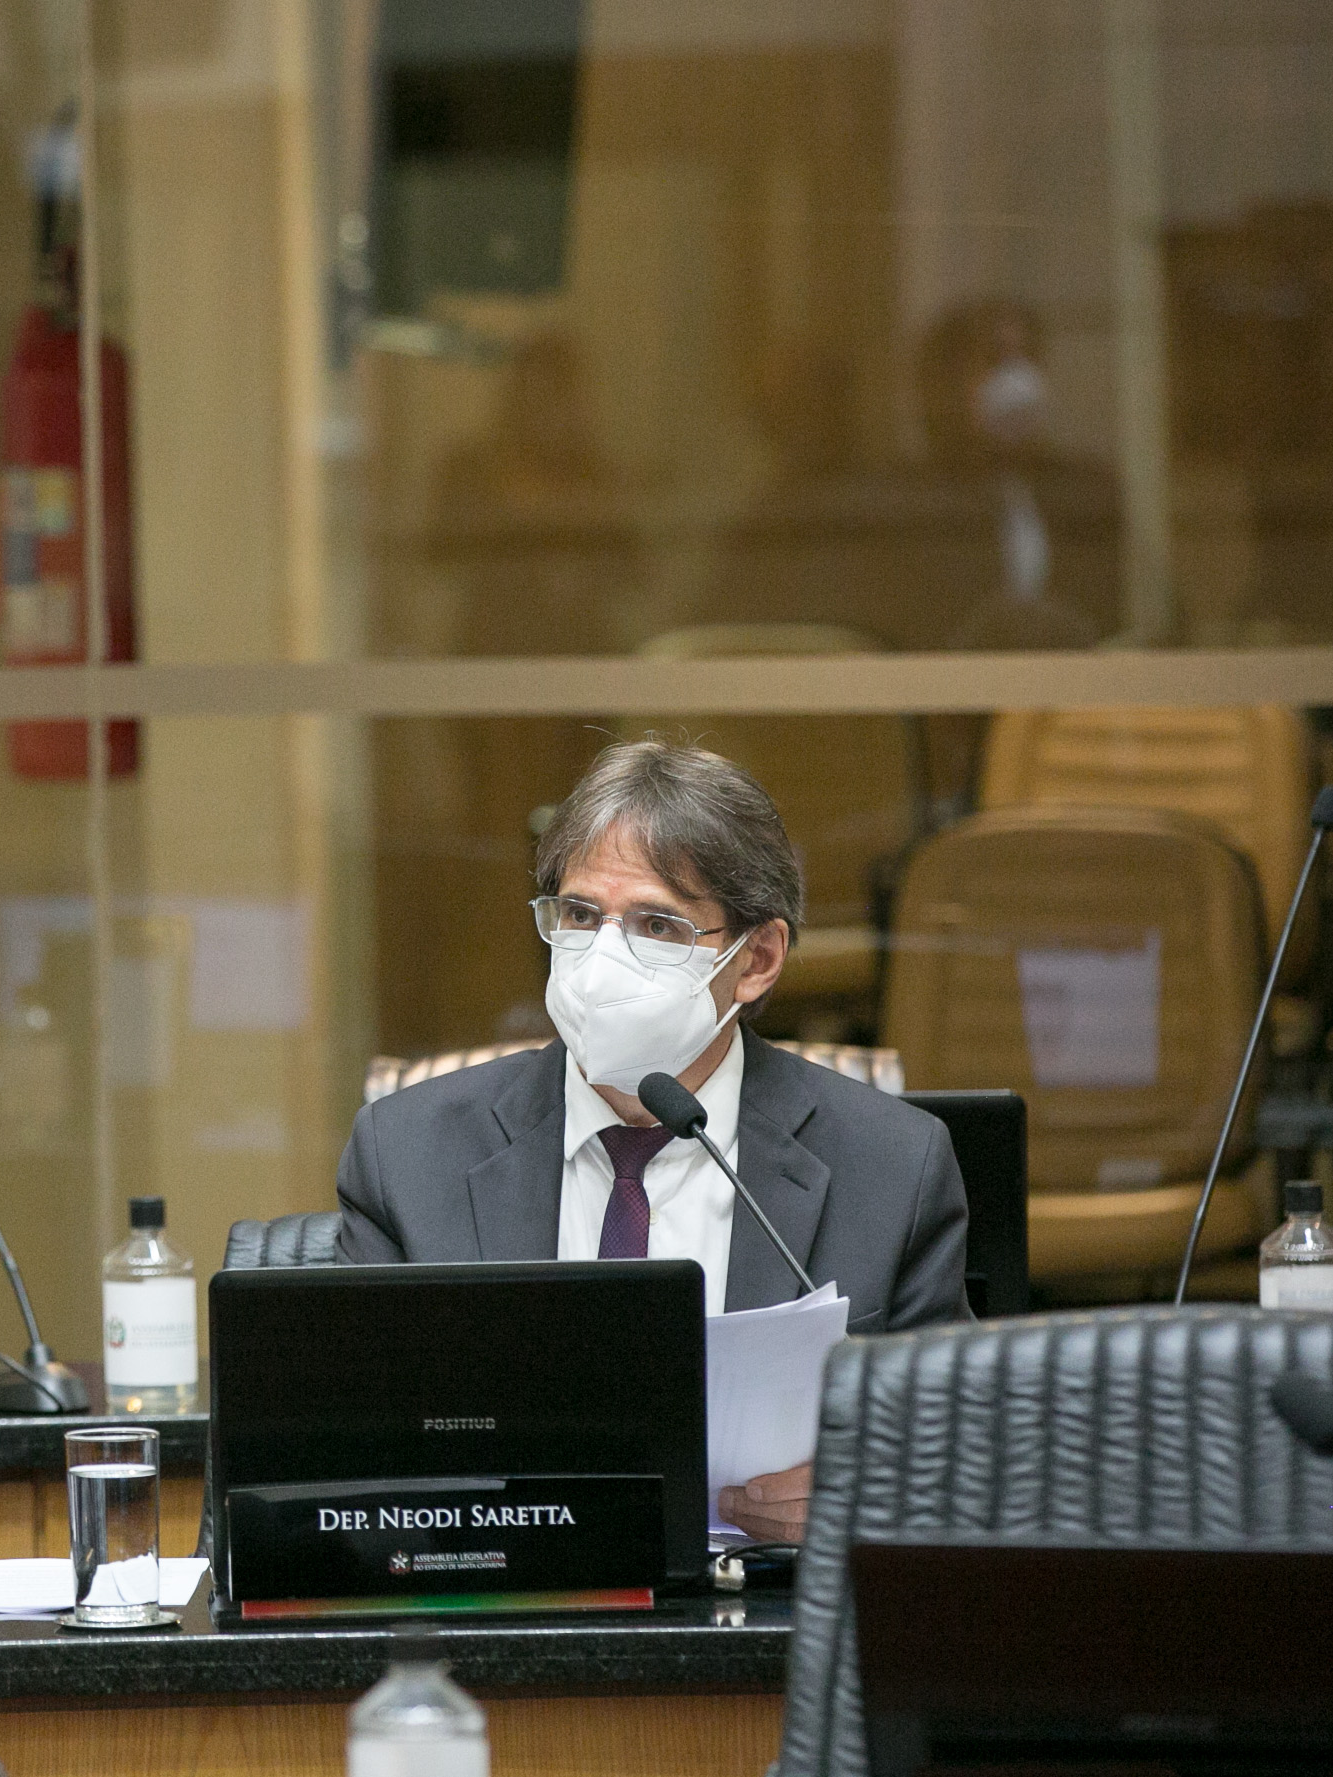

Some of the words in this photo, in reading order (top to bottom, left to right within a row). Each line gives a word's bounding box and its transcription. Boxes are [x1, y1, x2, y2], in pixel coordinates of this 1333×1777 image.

[319, 1508, 369, 1531] DEP.
[379, 1506, 462, 1530] NEODI
[471, 1504, 576, 1527] SARETTA
[413, 1553, 458, 1563] ASSEMBLEIA
[460, 1551, 507, 1562] LEGISLATIVA
[425, 1563, 447, 1571] ESTADO
